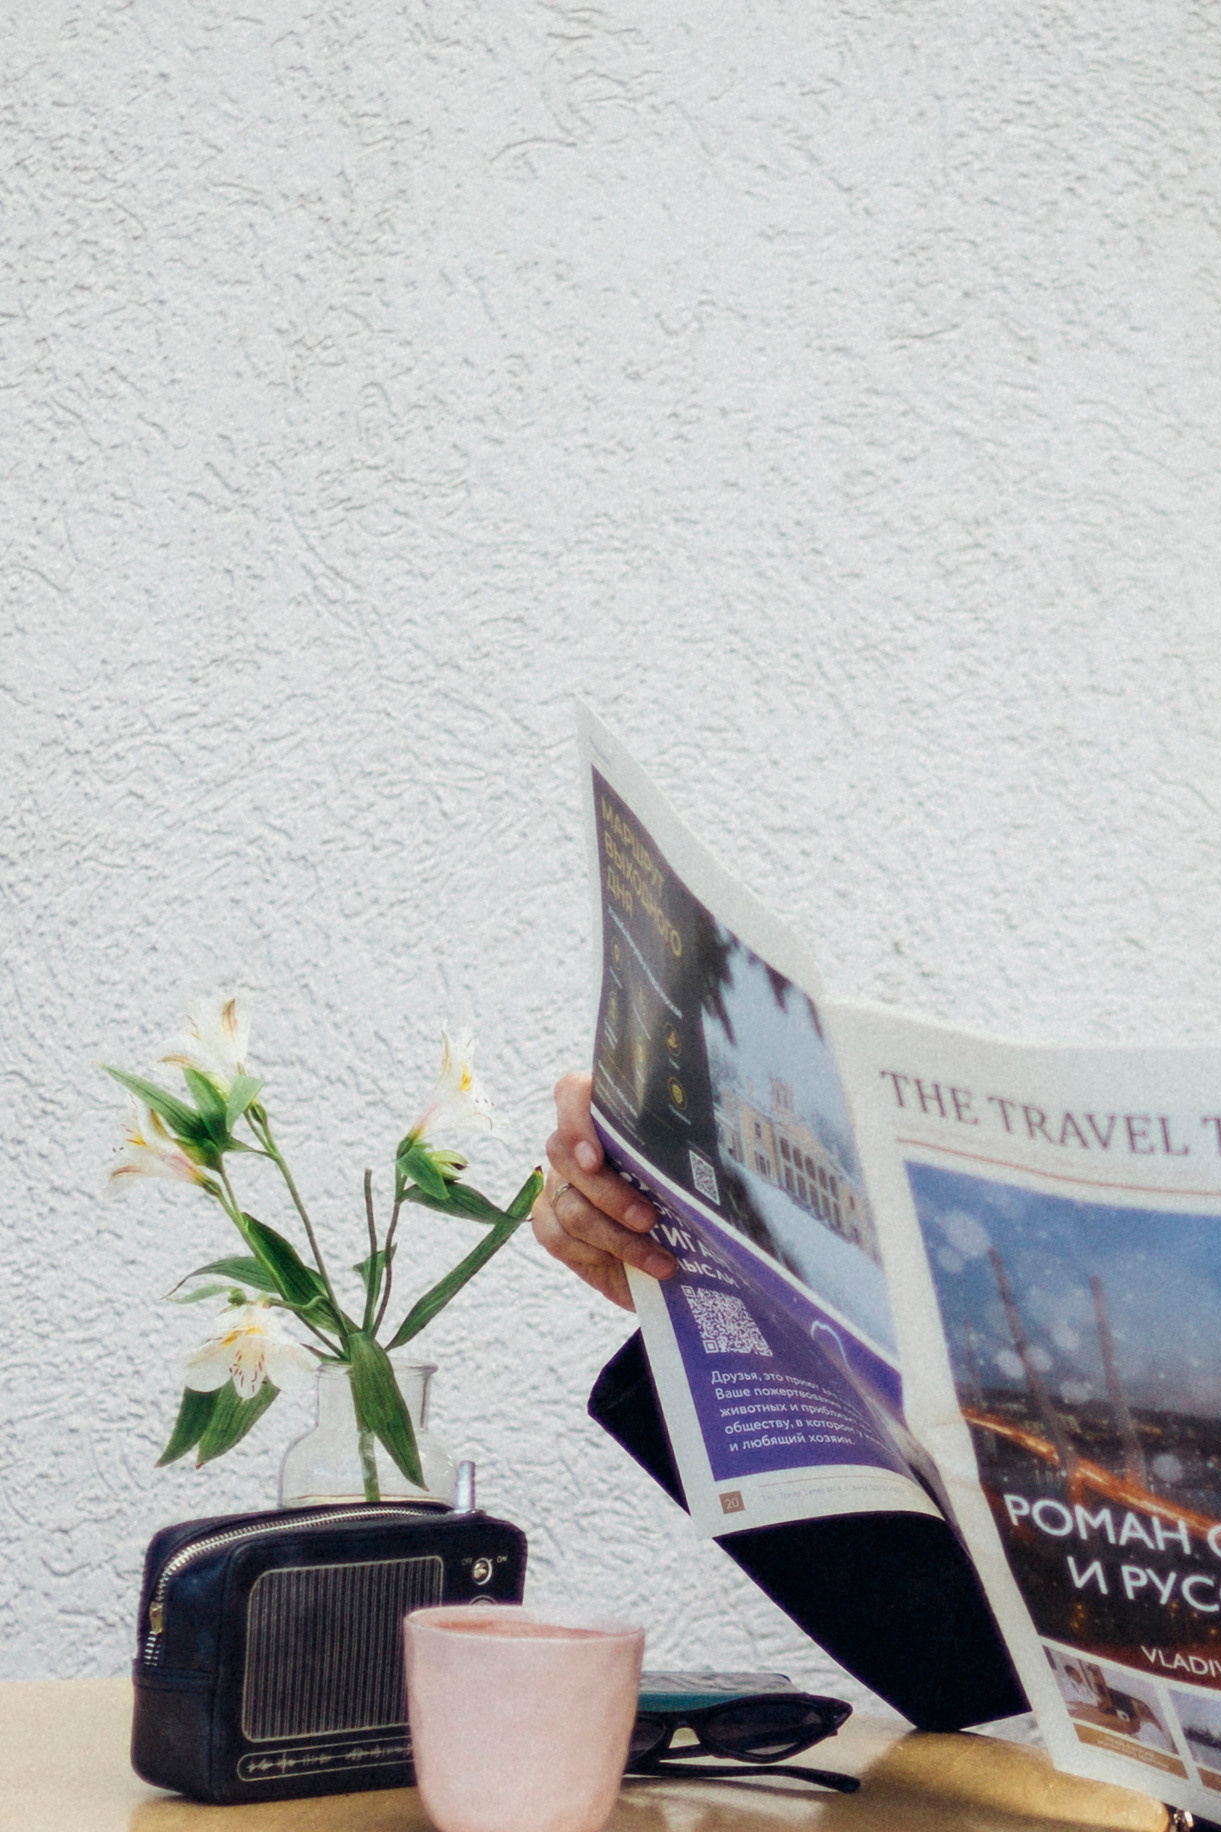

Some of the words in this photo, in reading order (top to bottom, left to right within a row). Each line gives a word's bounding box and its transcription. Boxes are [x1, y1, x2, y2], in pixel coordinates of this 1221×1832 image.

[880, 1070, 980, 1127] THE
[987, 1095, 1191, 1157] TRAVEL
[711, 1370, 762, 1384] Друзья,
[763, 1372, 783, 1381] это
[715, 1387, 751, 1400] Ваше
[720, 1403, 787, 1417] животных
[725, 1419, 794, 1435] обществу,
[796, 1419, 803, 1427] в
[729, 1442, 738, 1452] и
[742, 1433, 806, 1450] любящий
[724, 1497, 739, 1510] 20
[1003, 1494, 1190, 1554] РОМАН
[1067, 1556, 1108, 1593] И
